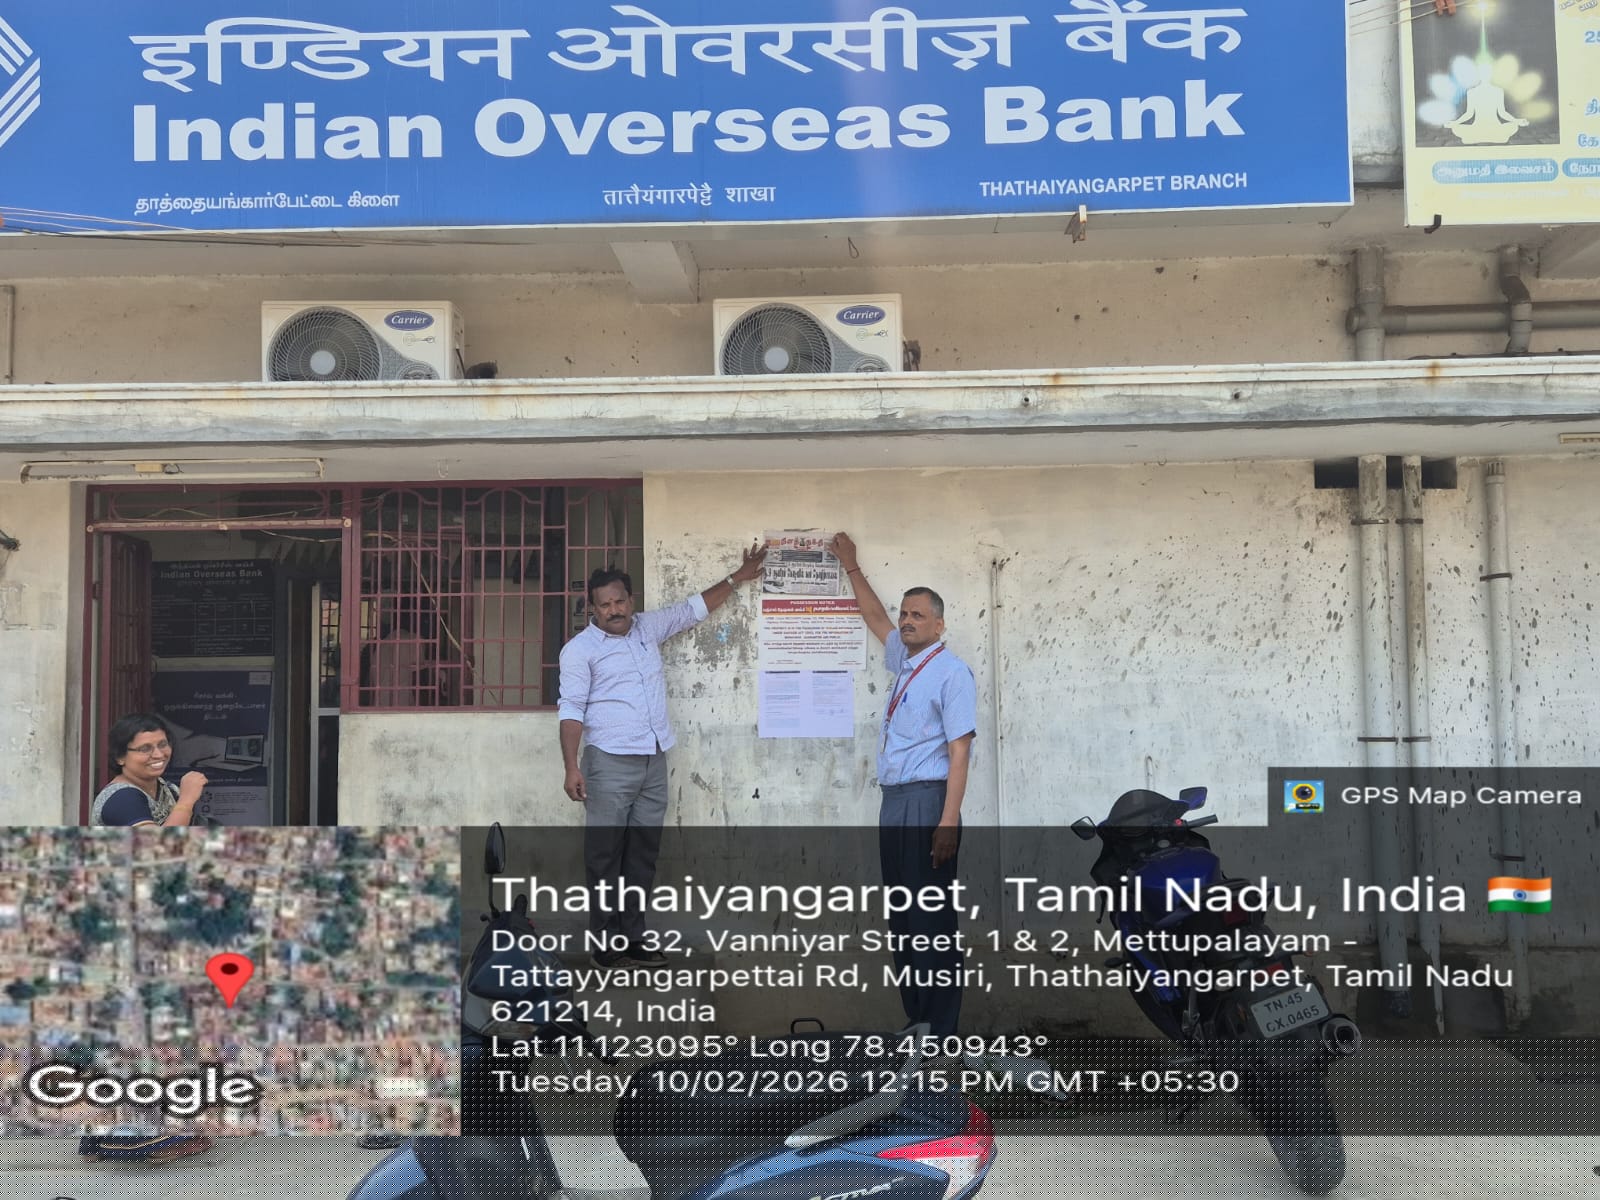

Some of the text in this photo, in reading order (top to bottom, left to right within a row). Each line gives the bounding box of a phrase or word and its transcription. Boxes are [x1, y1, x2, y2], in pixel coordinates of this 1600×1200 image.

[129, 0, 1248, 92] इण्डियन ओवरसीज़ बैंक
[133, 79, 1245, 162] Indian Overseas Bank
[725, 186, 777, 203] शाखा
[979, 172, 1248, 197] THATHAIYANGARPET BRANCH
[134, 190, 400, 216] தாத்தையங்கார்பேட்டை கிளை
[391, 315, 428, 325] Carrier
[843, 310, 880, 321] Carrier
[193, 569, 237, 578] Overseas
[239, 568, 263, 577] Bank
[1264, 992, 1303, 1013] TN.45
[1265, 1005, 1320, 1033] CX.0465
